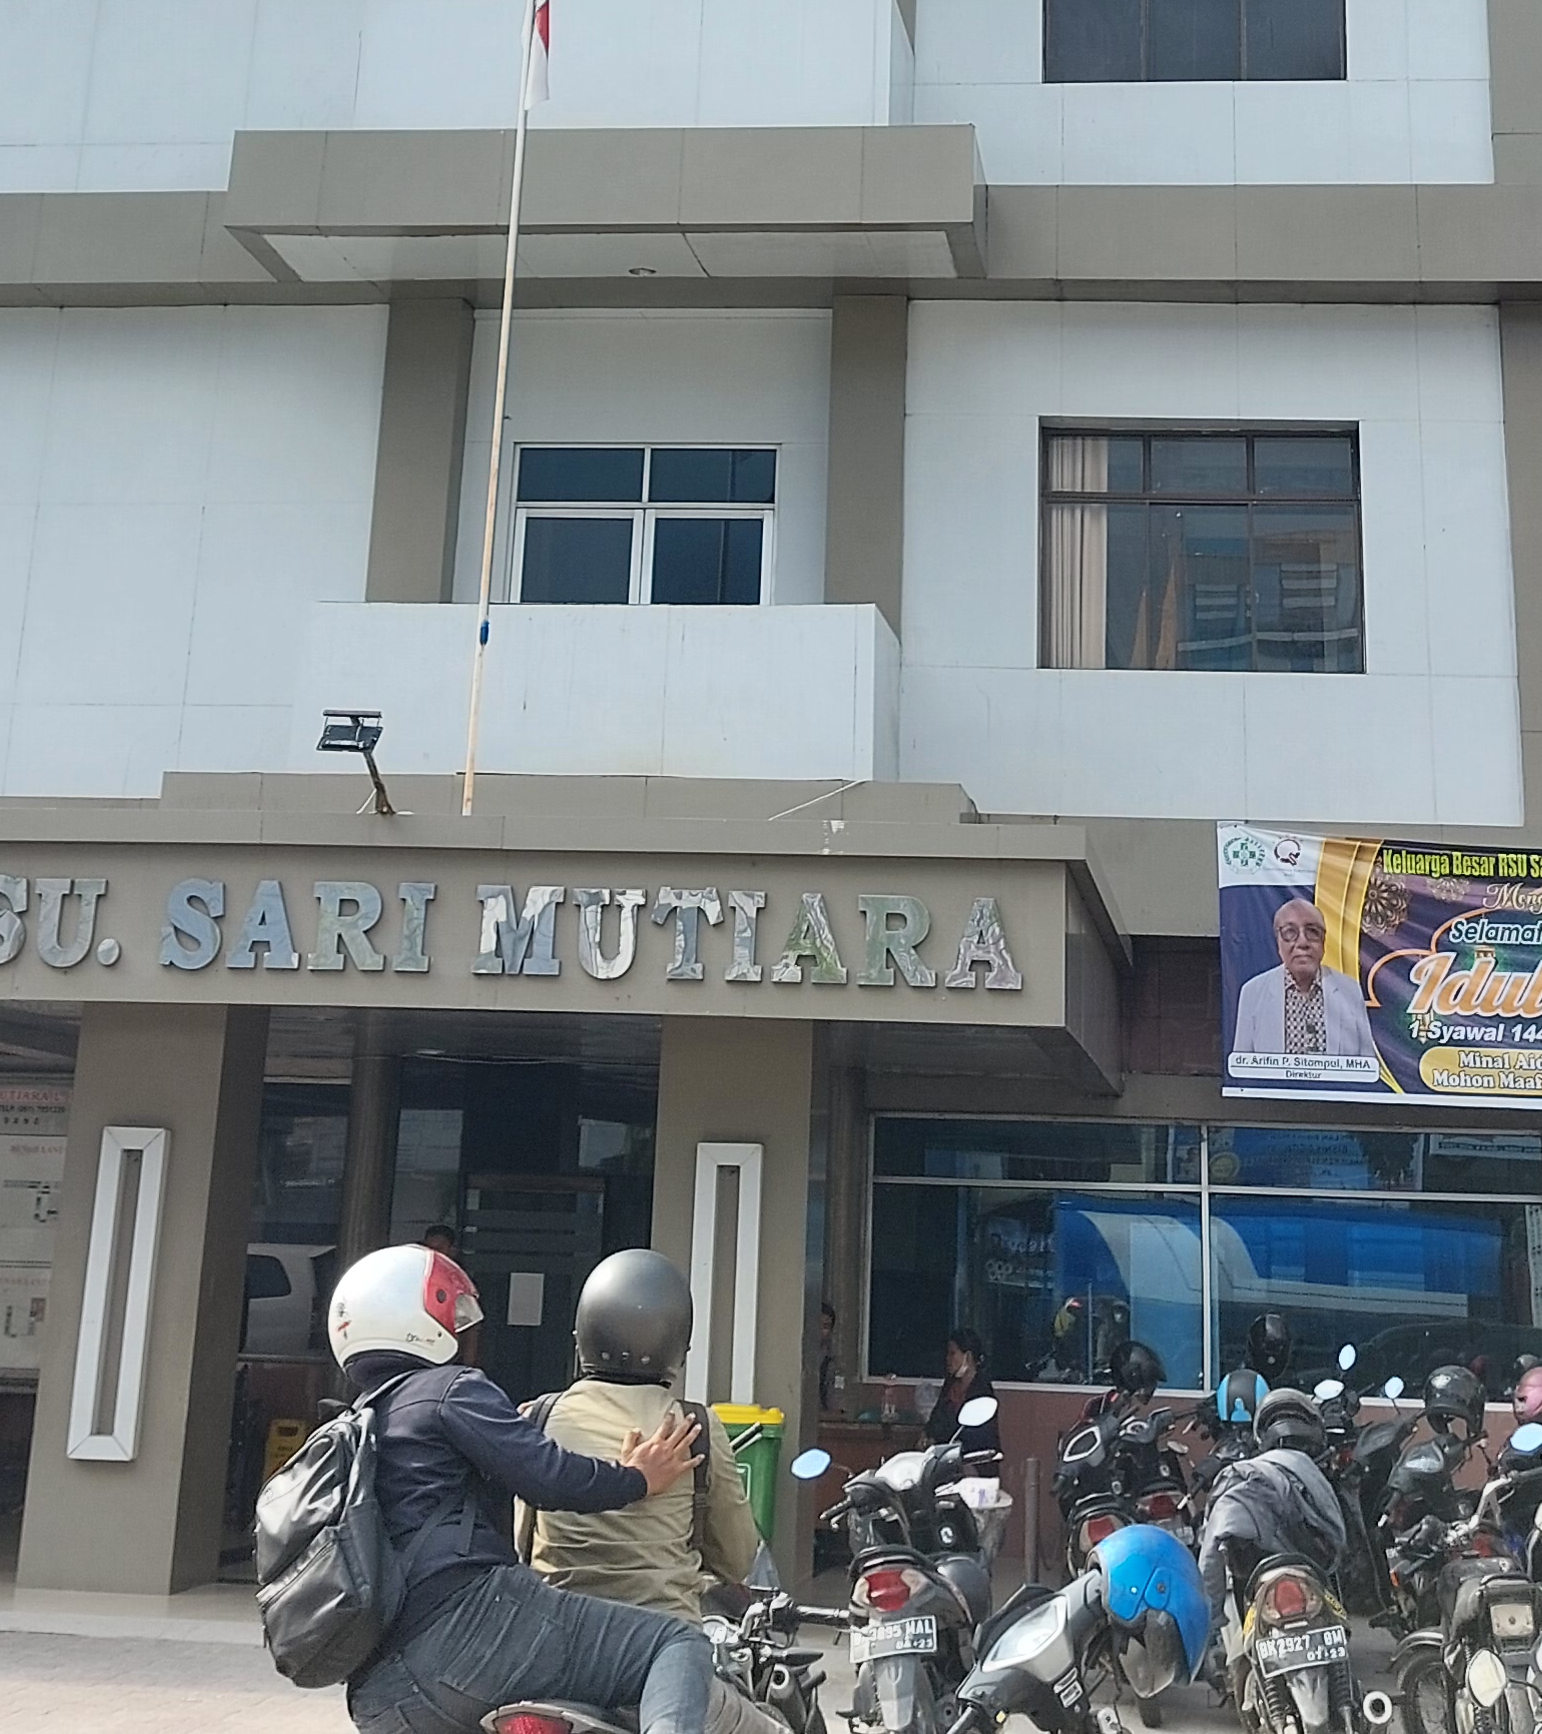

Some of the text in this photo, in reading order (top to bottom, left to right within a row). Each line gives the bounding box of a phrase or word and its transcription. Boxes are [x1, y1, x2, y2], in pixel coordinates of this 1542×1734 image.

[1383, 849, 1449, 878] Keluarga
[1452, 851, 1496, 877] Besar
[1498, 853, 1527, 877] RSU
[160, 878, 438, 972] SARI
[471, 885, 1023, 991] MUTIARA
[1426, 1021, 1505, 1045] Syawal
[1250, 1056, 1279, 1066] Arifin
[1346, 1058, 1371, 1069] MHA
[1458, 1050, 1511, 1070] Minal
[1285, 1070, 1323, 1079] Direktur
[1432, 1070, 1496, 1089] Mohon
